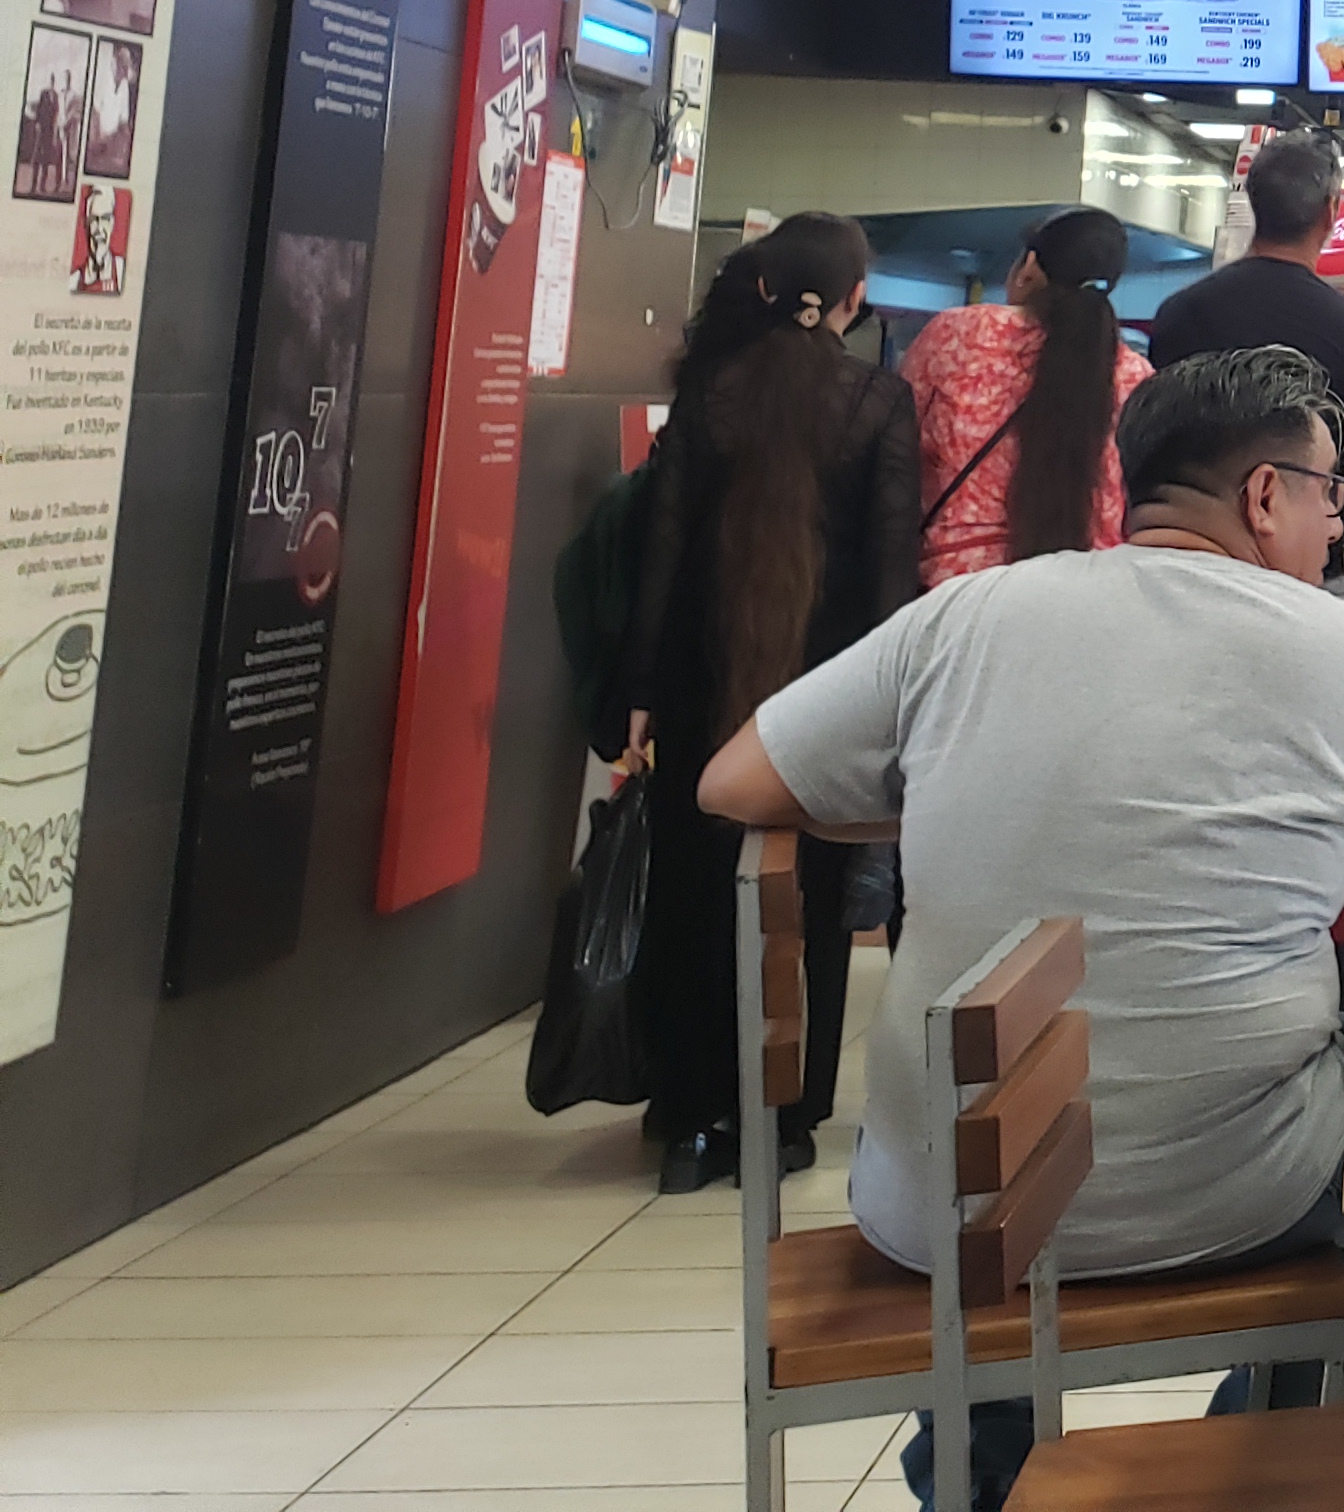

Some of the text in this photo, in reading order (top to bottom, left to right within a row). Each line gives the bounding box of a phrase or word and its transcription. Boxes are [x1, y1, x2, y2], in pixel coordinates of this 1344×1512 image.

[1198, 16, 1270, 27] SANDWICH SPECIALS
[310, 387, 336, 450] 7
[248, 430, 305, 515] 10
